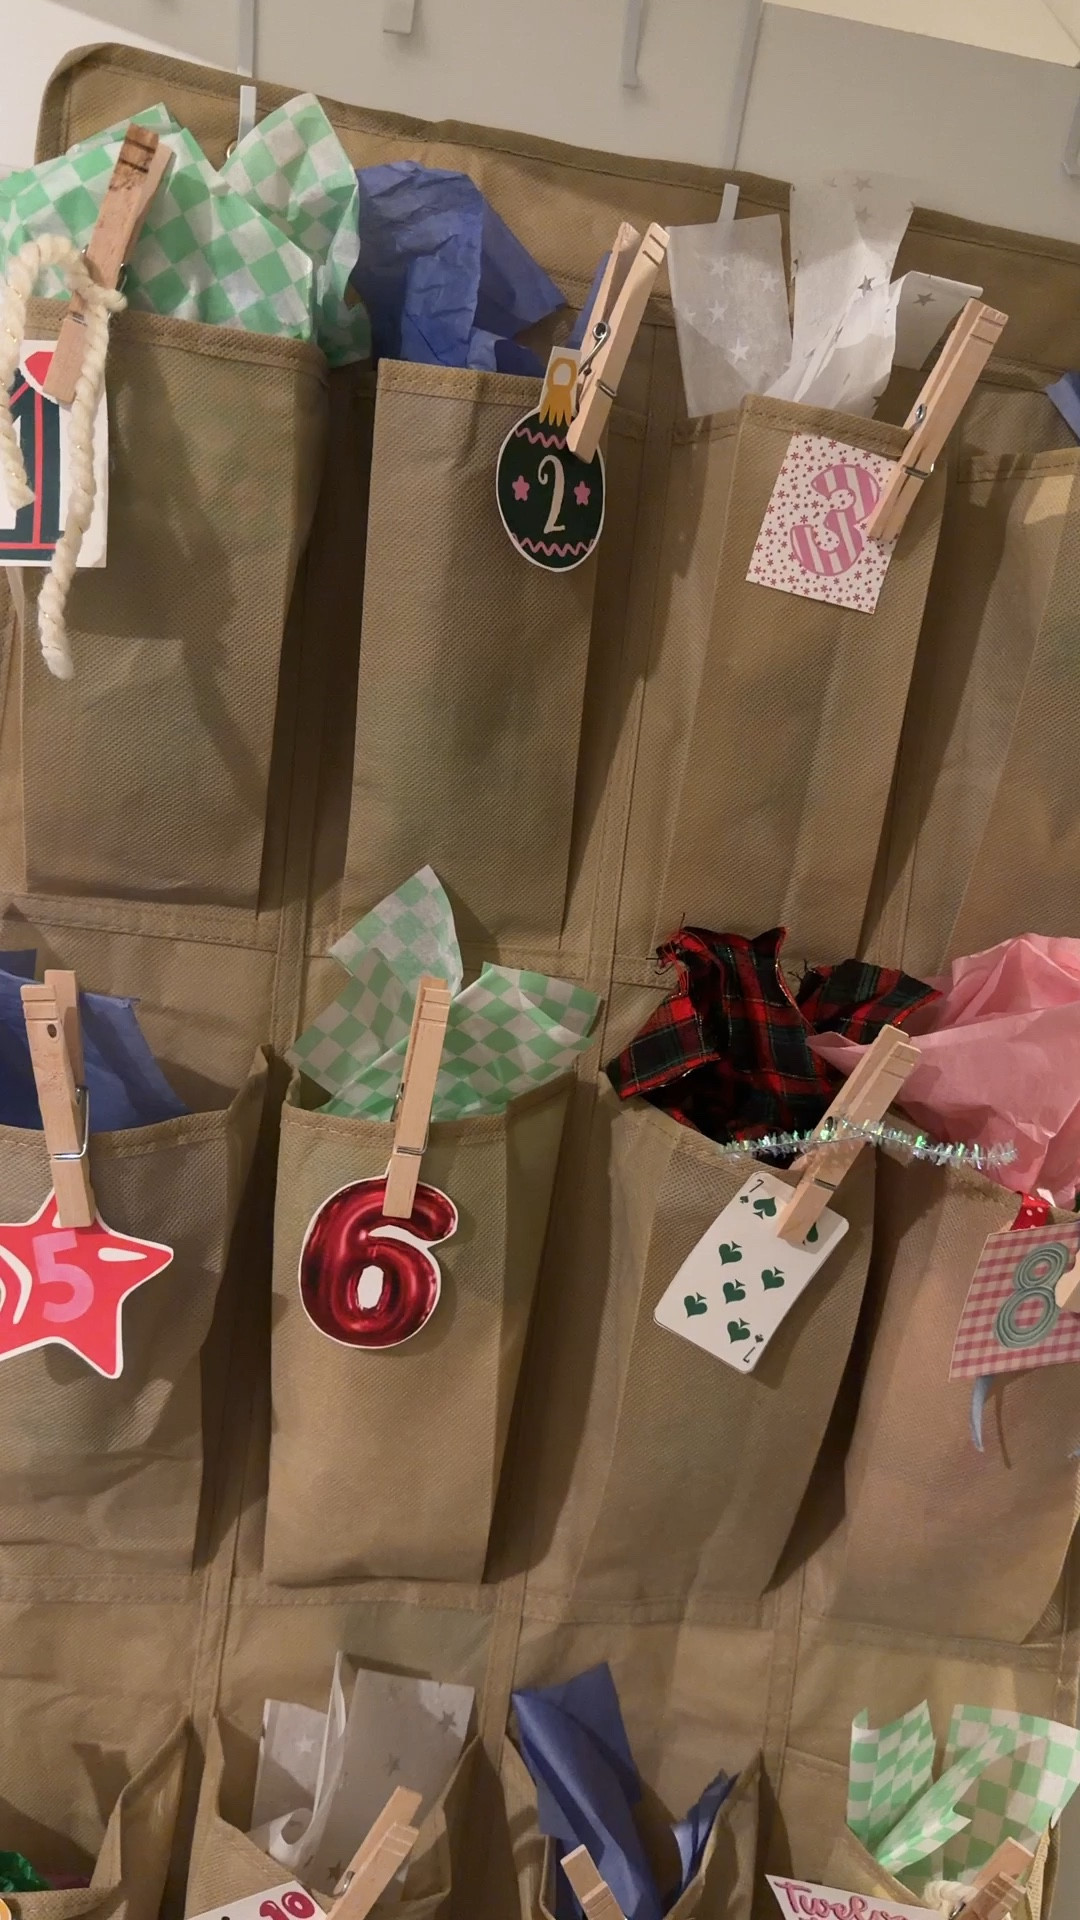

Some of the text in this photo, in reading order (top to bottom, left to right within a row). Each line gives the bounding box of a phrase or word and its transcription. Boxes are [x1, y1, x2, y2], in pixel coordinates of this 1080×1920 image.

[537, 454, 566, 534] 2
[789, 463, 880, 577] 3
[748, 1178, 765, 1194] 7
[32, 1230, 95, 1323] 5
[300, 1176, 458, 1348] 6
[994, 1242, 1069, 1349] 8
[742, 1346, 756, 1364] 7
